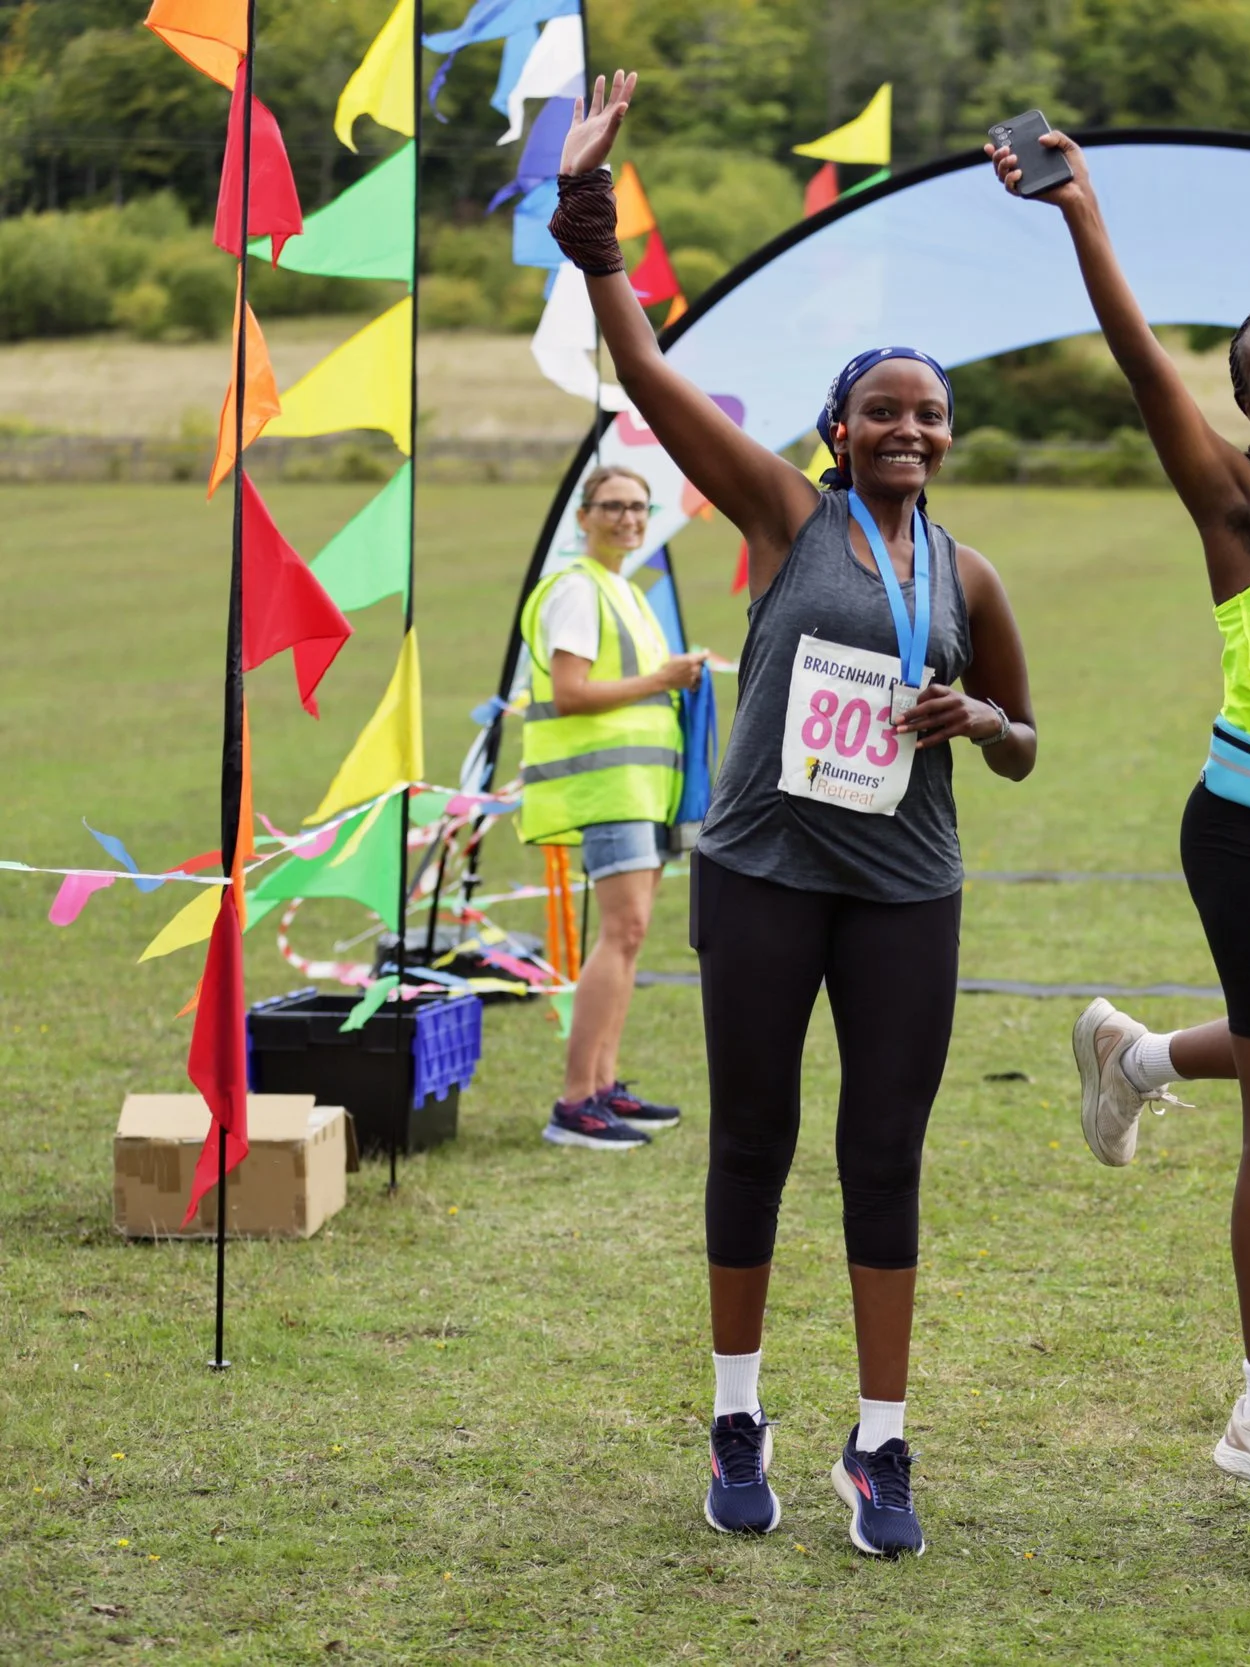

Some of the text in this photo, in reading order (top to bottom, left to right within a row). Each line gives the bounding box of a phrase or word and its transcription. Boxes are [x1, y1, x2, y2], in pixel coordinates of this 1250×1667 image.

[803, 655, 886, 689] BRADENHAM
[801, 689, 899, 768] 803
[821, 761, 885, 789] Runners'
[816, 777, 875, 807] Retreat
